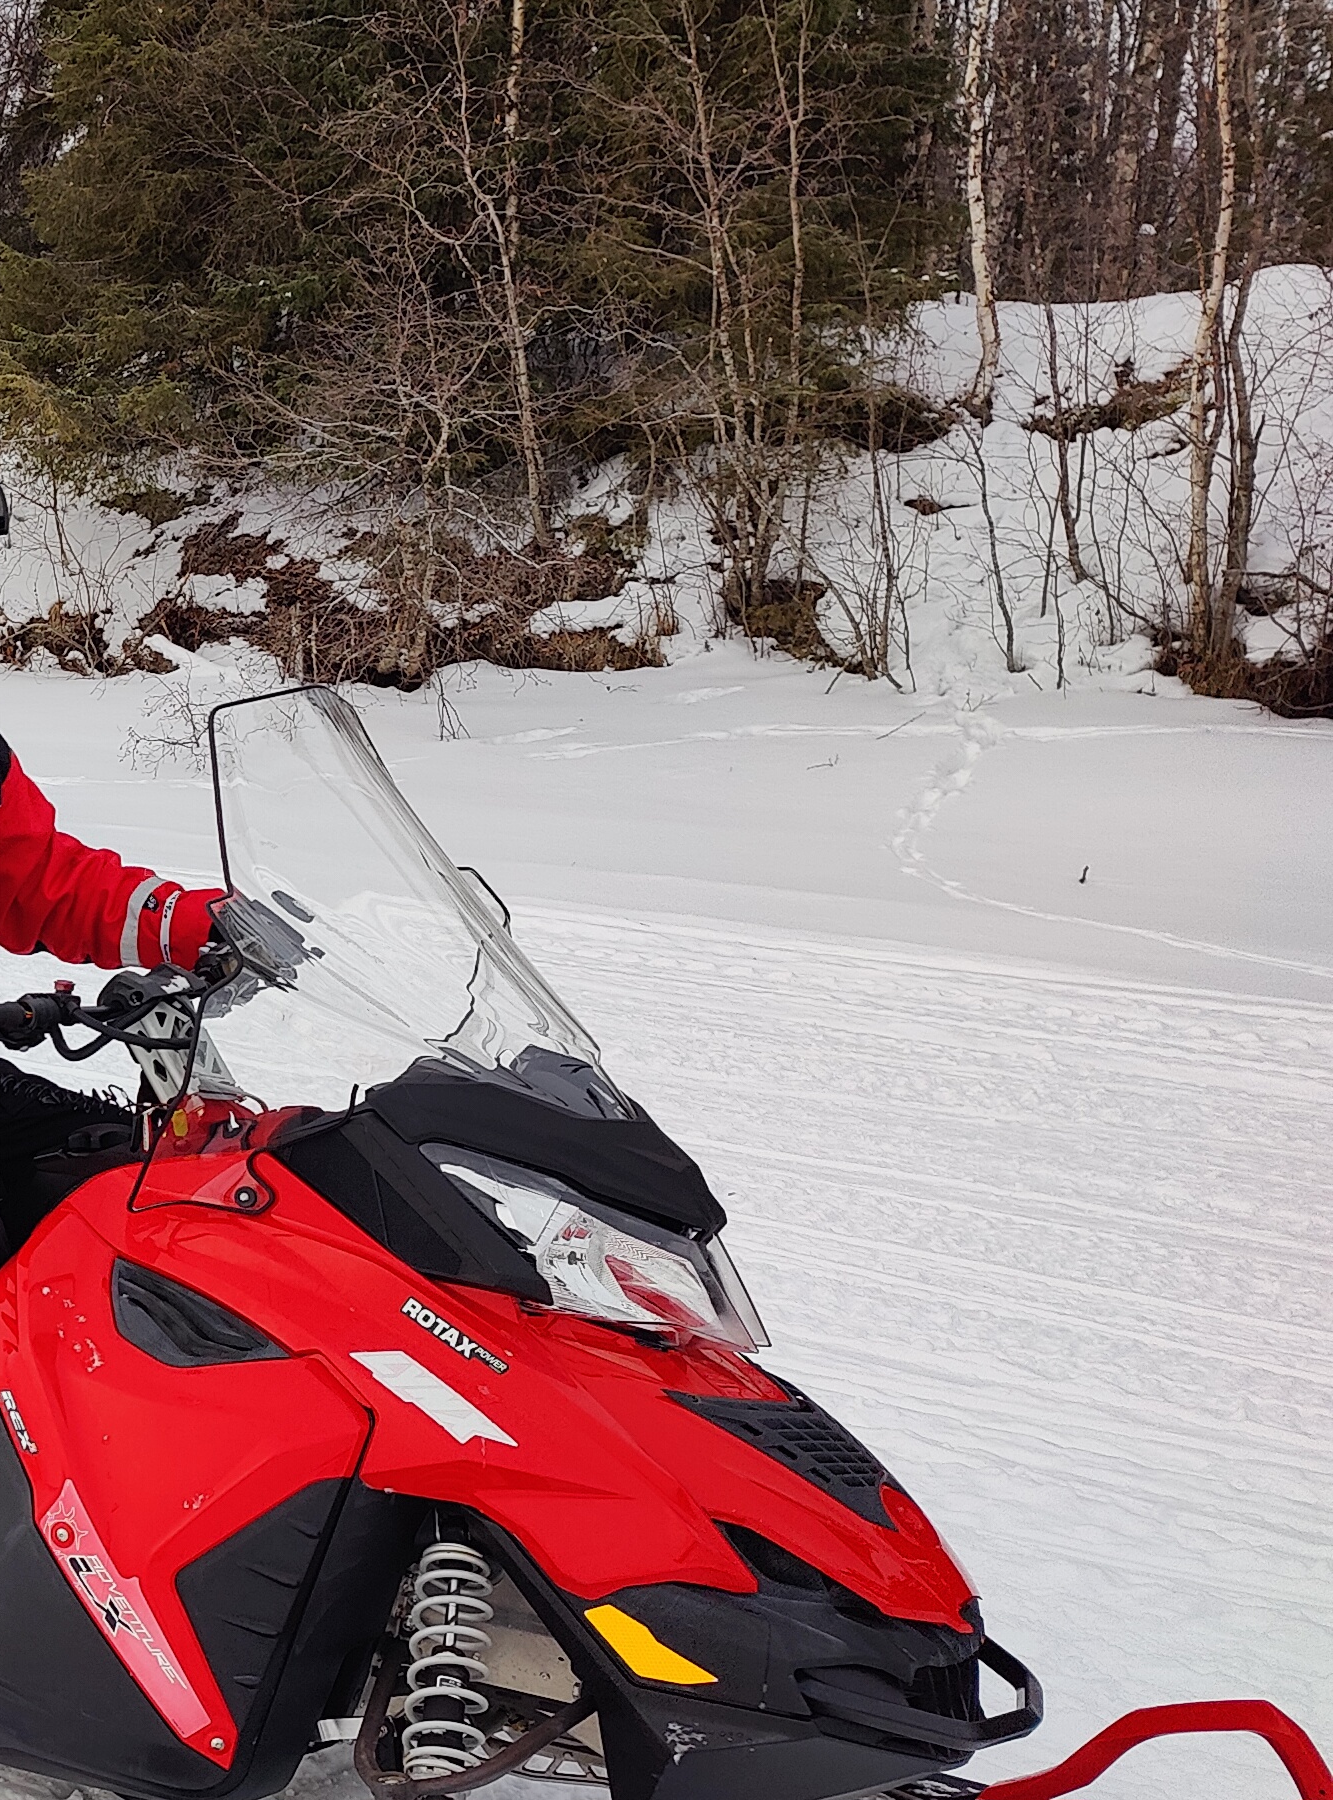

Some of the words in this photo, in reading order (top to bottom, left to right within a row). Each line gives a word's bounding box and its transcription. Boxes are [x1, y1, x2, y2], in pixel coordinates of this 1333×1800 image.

[401, 1297, 479, 1359] ROTAX
[474, 1346, 508, 1372] POWER
[87, 1555, 188, 1690] ADVENTURE
